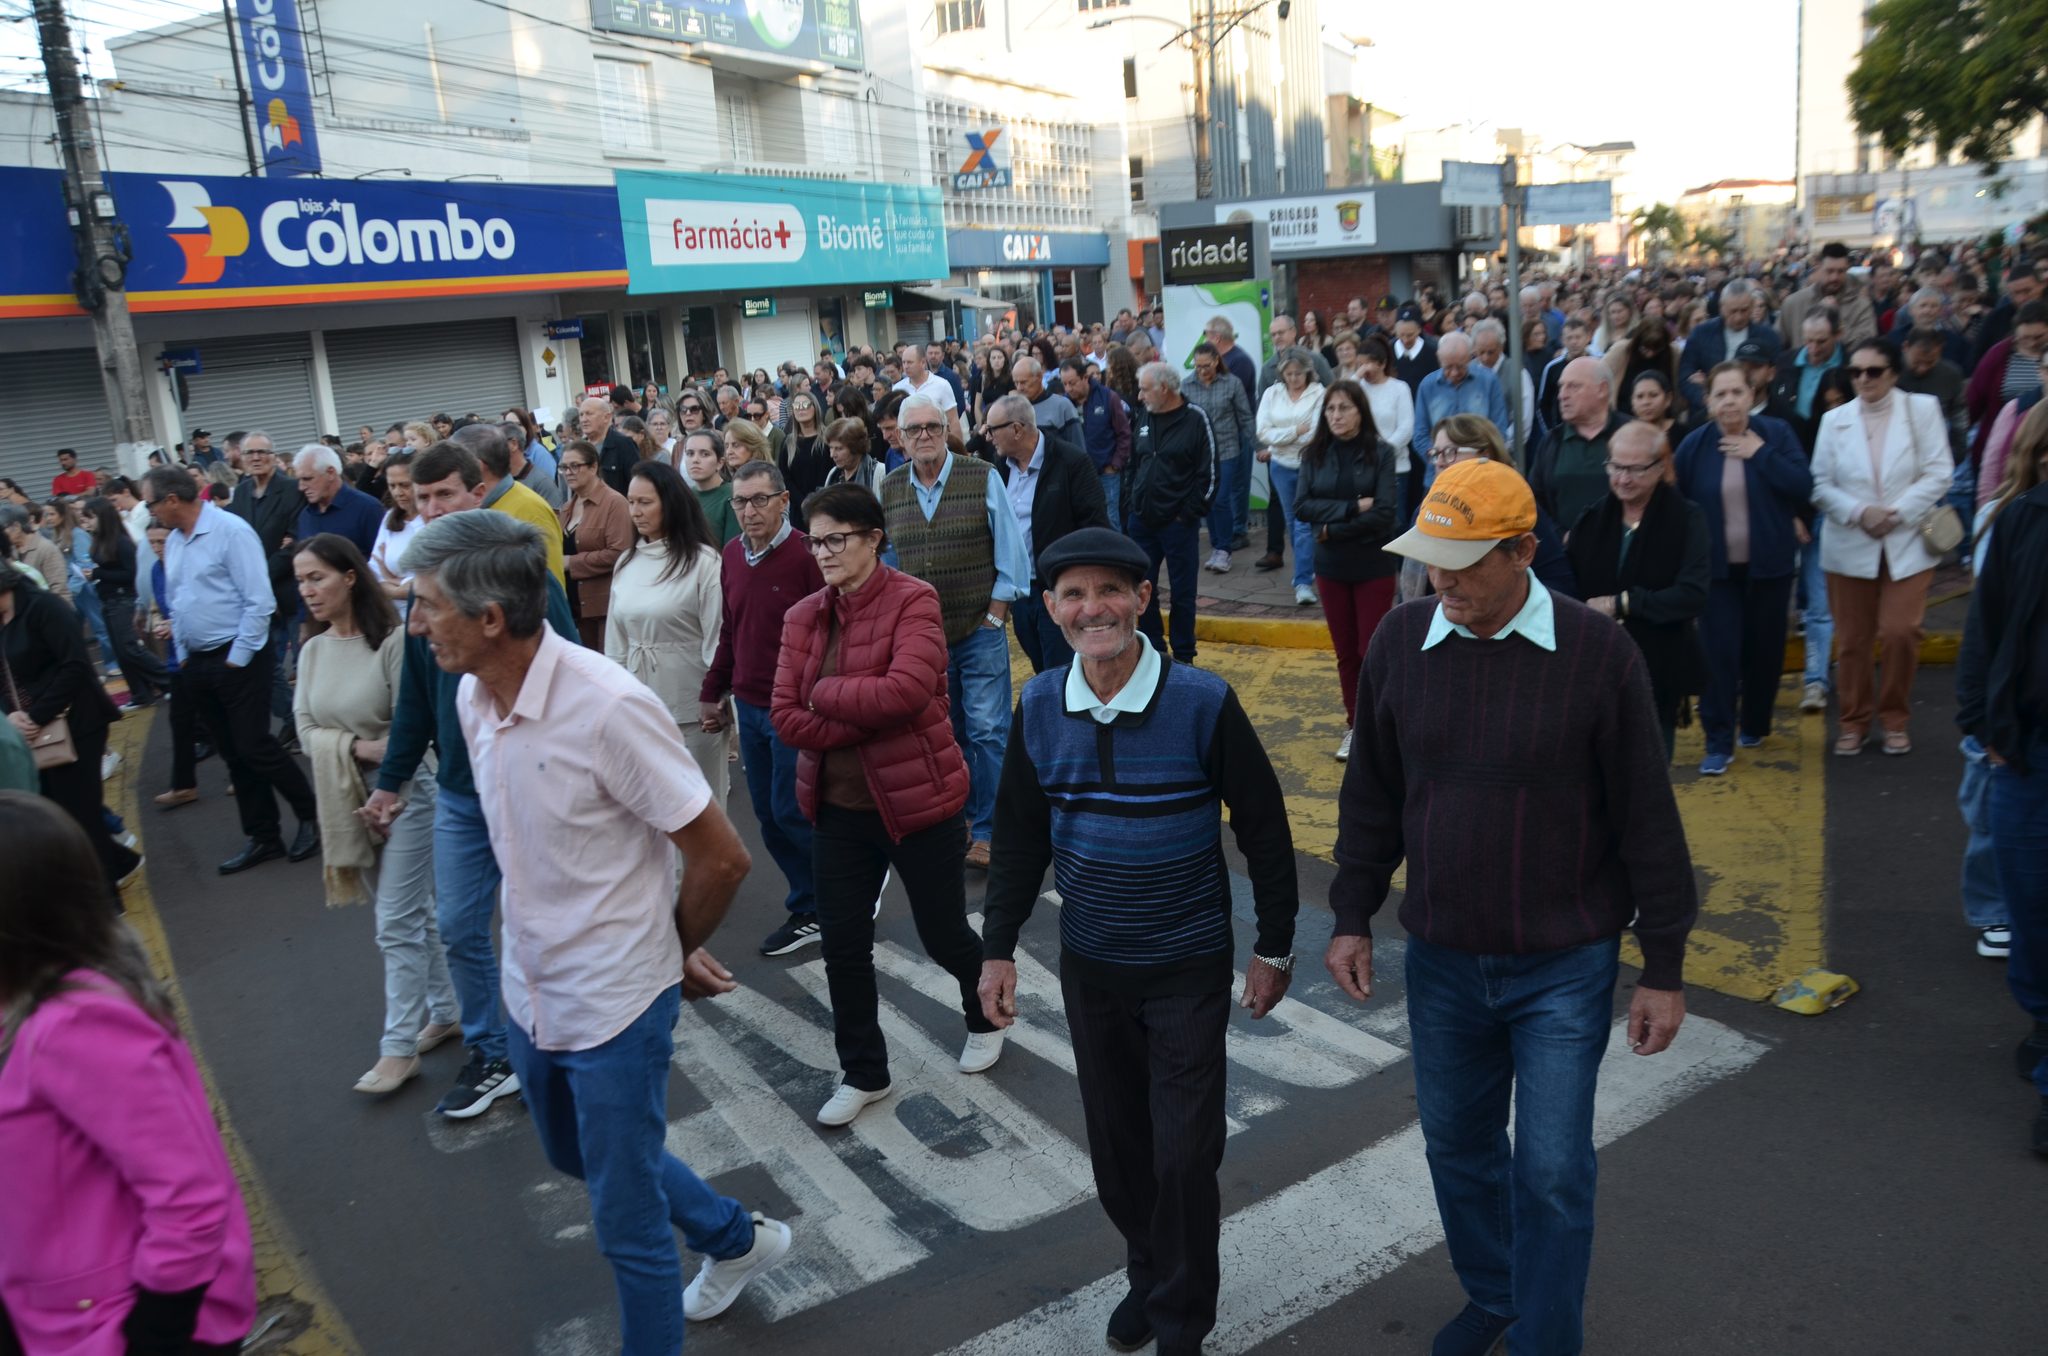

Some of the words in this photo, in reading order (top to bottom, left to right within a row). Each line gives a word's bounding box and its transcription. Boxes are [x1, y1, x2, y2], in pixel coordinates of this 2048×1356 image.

[957, 170, 1006, 189] CAIXA
[298, 198, 324, 215] lojas
[1270, 206, 1318, 221] BRIGADA
[260, 200, 516, 268] Colombo
[1271, 221, 1318, 237] MILITAR
[1003, 234, 1051, 261] CAIXA
